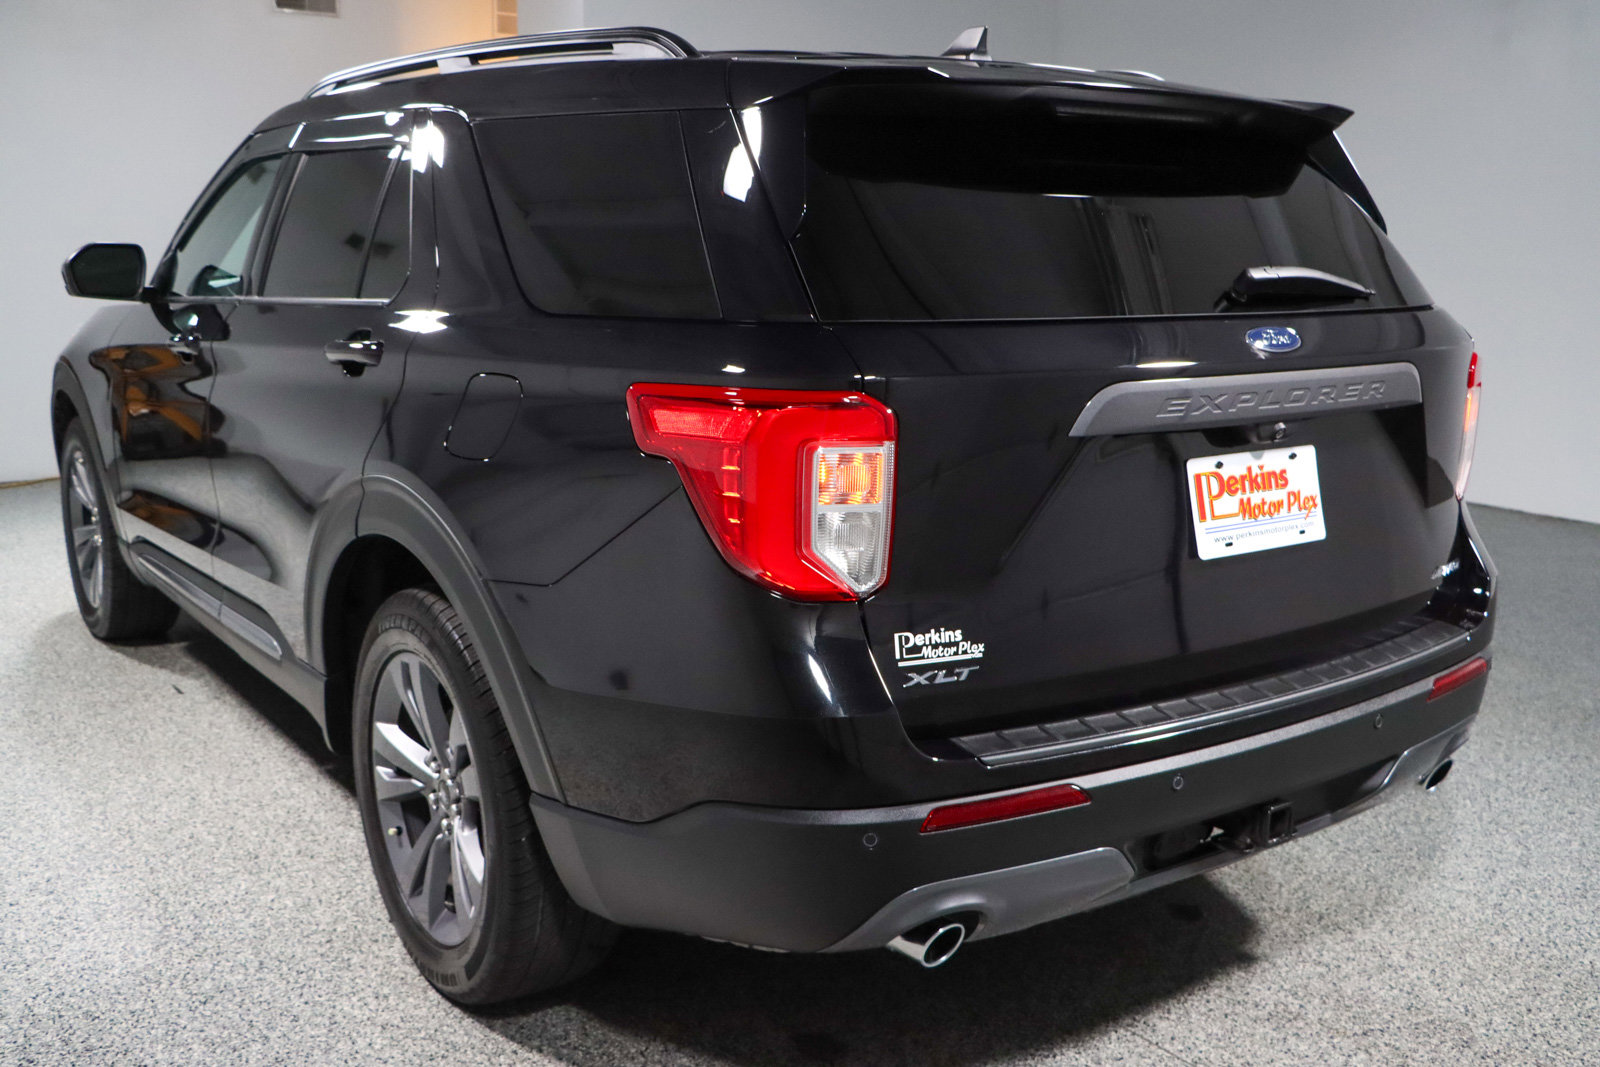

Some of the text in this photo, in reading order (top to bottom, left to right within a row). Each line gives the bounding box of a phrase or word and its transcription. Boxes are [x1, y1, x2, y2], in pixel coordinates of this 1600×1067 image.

[1256, 328, 1293, 347] Ford
[1156, 380, 1386, 417] EXPLORER
[1194, 464, 1289, 522] Perkins
[1239, 489, 1318, 520] Motor Plex
[1213, 520, 1315, 543] wwwperkinsmotorplexcom
[894, 627, 963, 659] Perkins
[921, 640, 985, 659] Motor Plex
[902, 665, 980, 688] XLT
